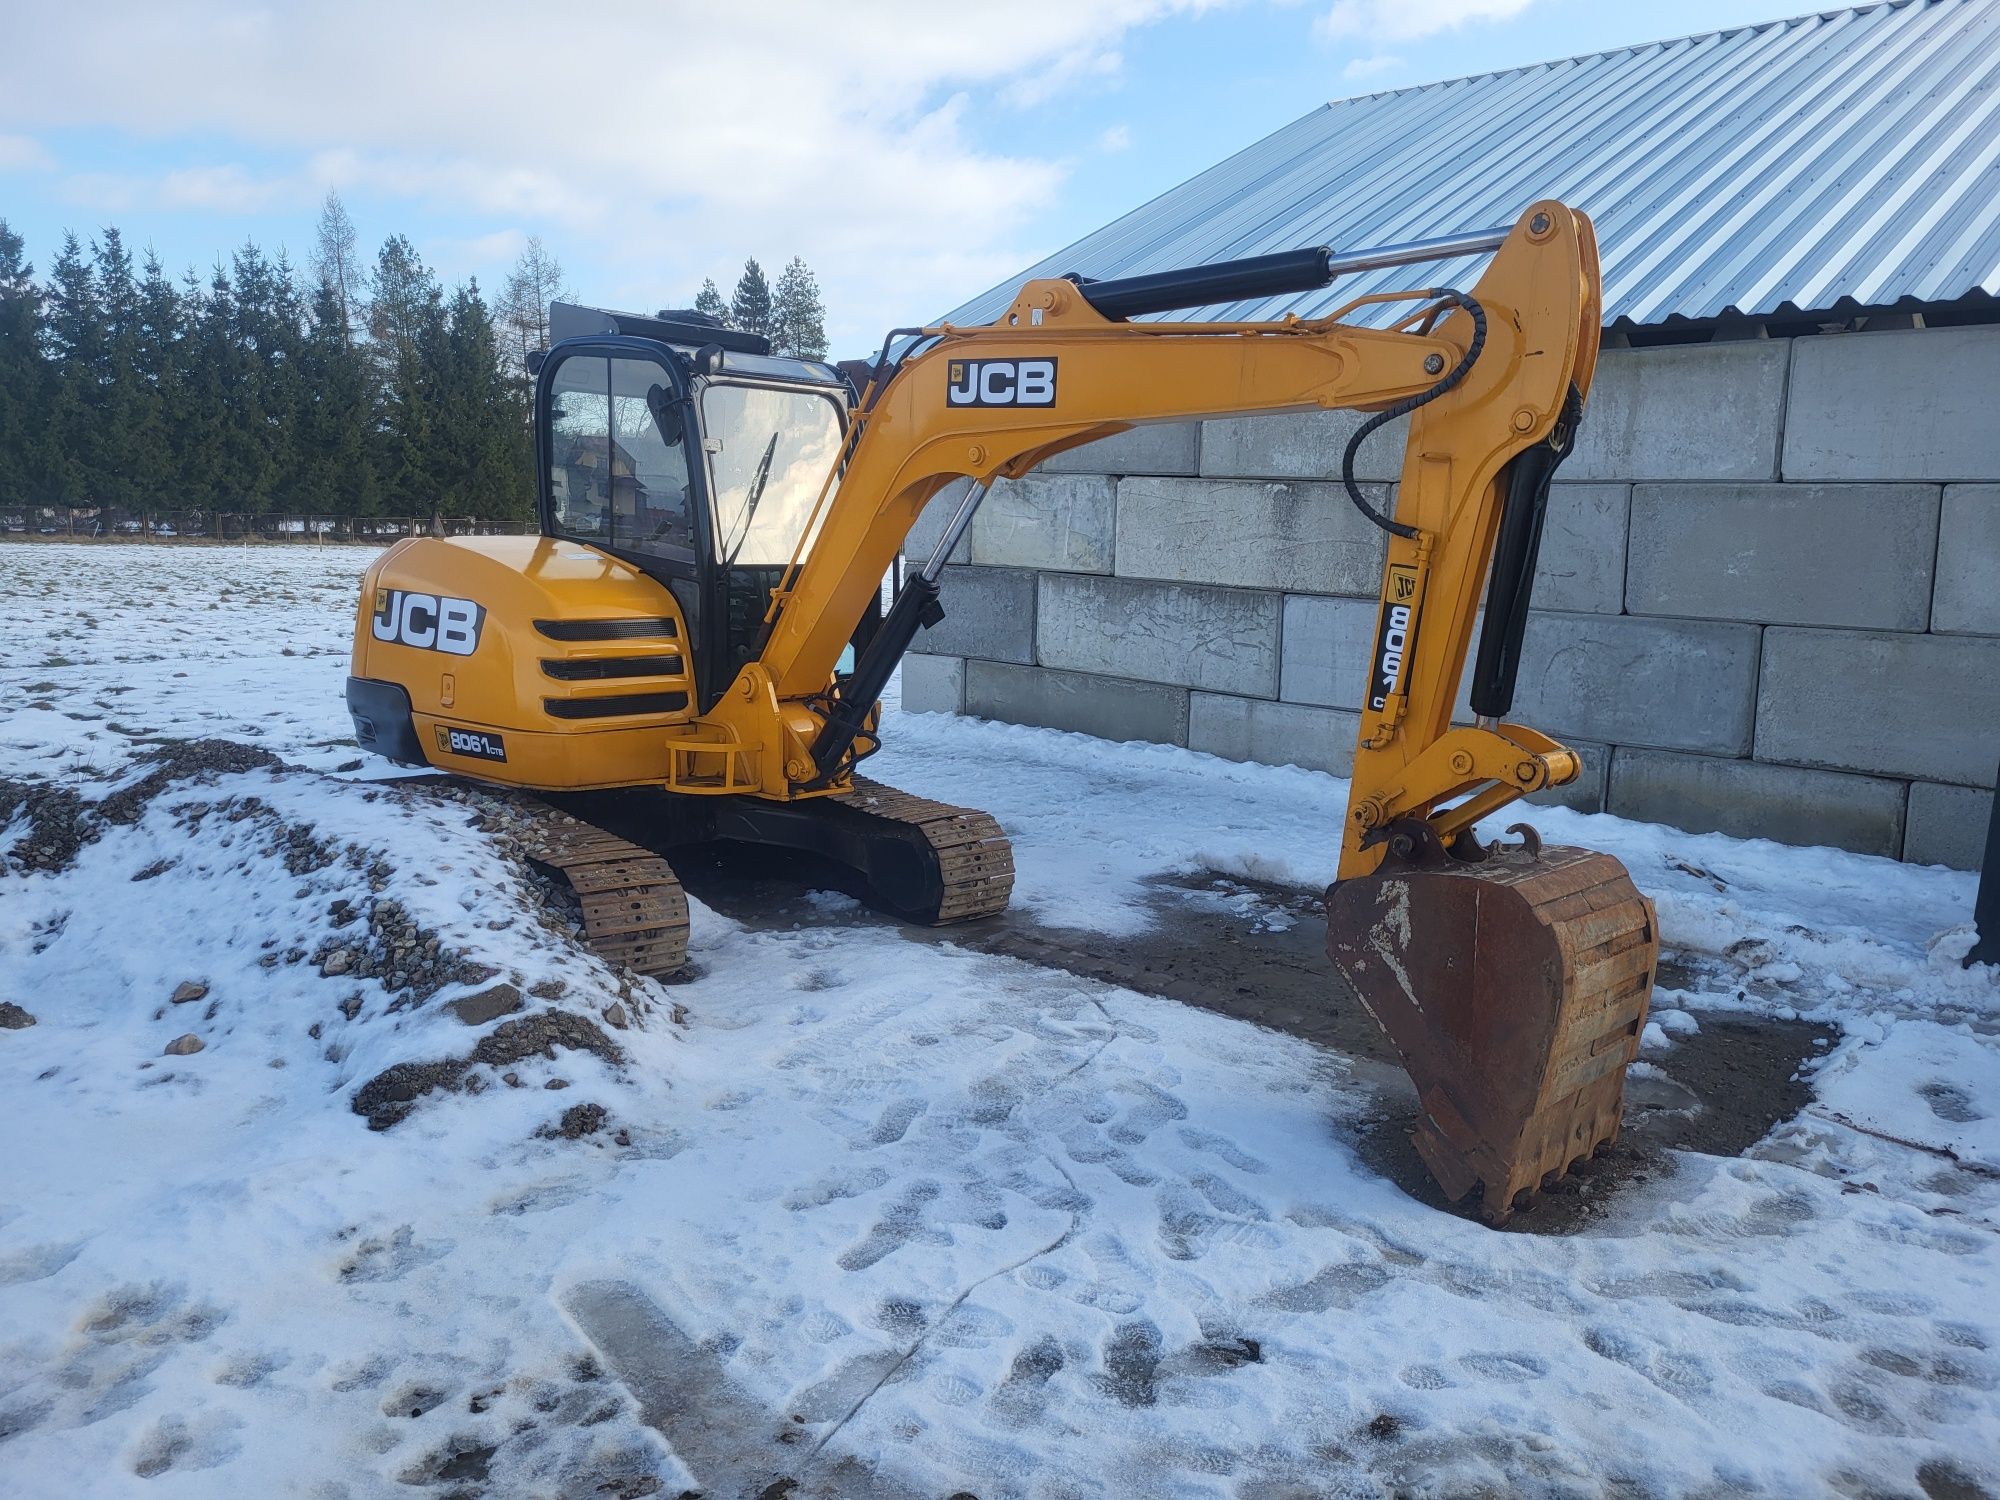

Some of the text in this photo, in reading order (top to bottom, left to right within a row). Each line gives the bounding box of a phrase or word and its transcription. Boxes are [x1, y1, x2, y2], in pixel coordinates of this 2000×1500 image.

[950, 361, 1054, 404] JCB
[373, 591, 478, 655] JCB
[450, 731, 490, 754] 8061
